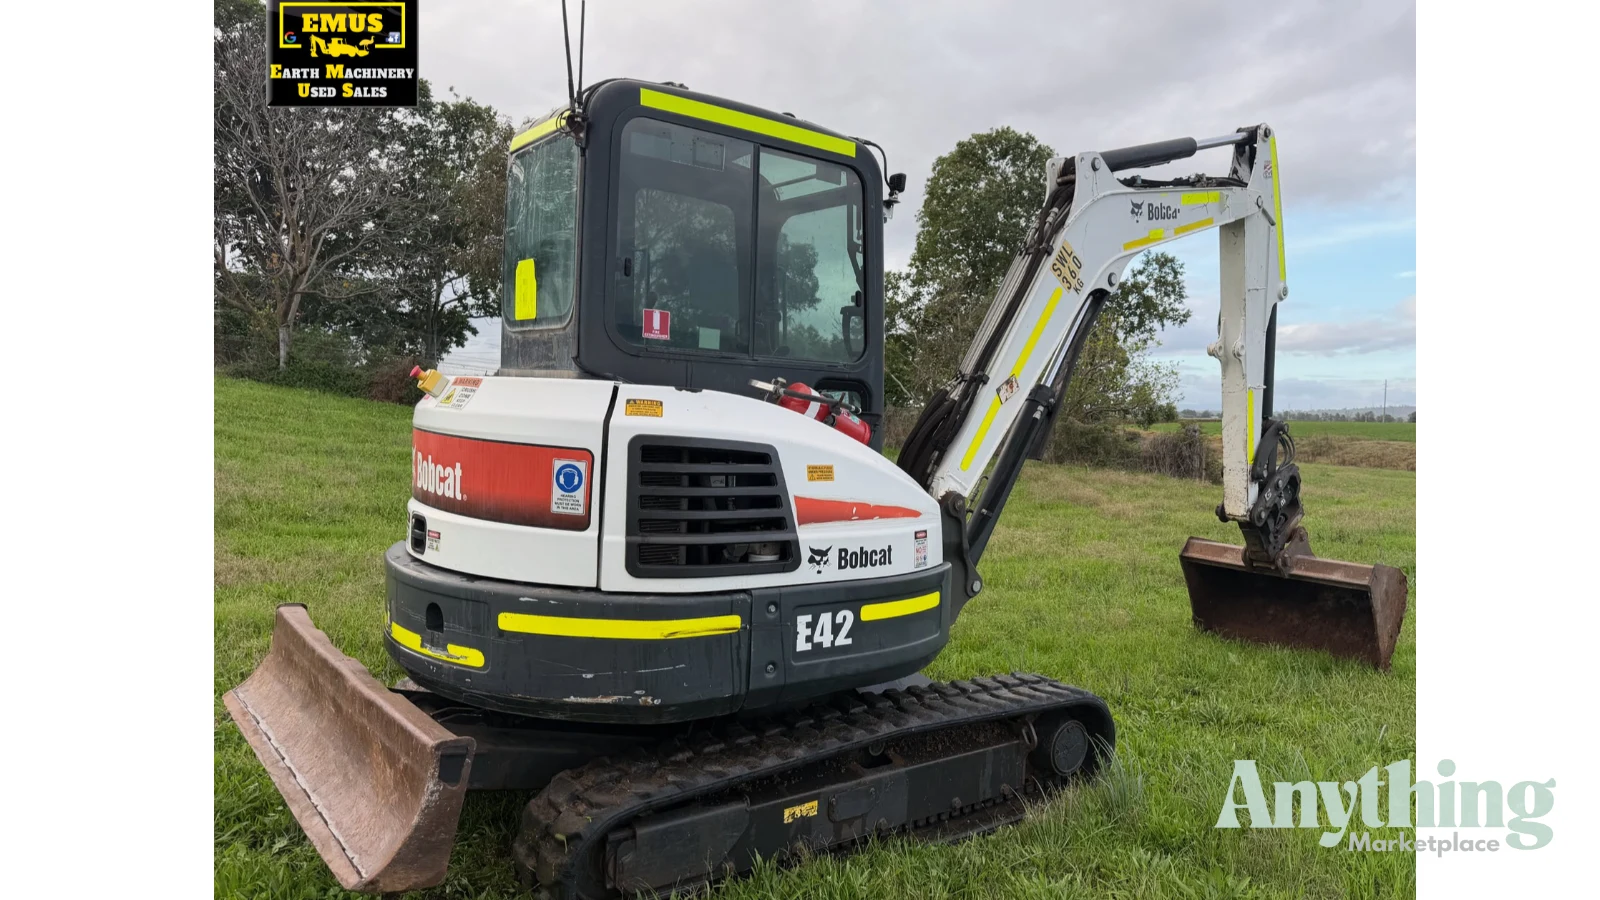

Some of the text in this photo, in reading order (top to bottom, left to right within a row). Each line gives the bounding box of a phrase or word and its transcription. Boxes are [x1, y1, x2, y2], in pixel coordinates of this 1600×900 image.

[1147, 202, 1180, 221] Bobca
[1051, 245, 1073, 277] SWL
[1061, 255, 1082, 290] 360
[1073, 277, 1084, 295] KG
[417, 451, 462, 501] Bobcat
[838, 545, 892, 570] Bobcat
[796, 609, 854, 652] E42
